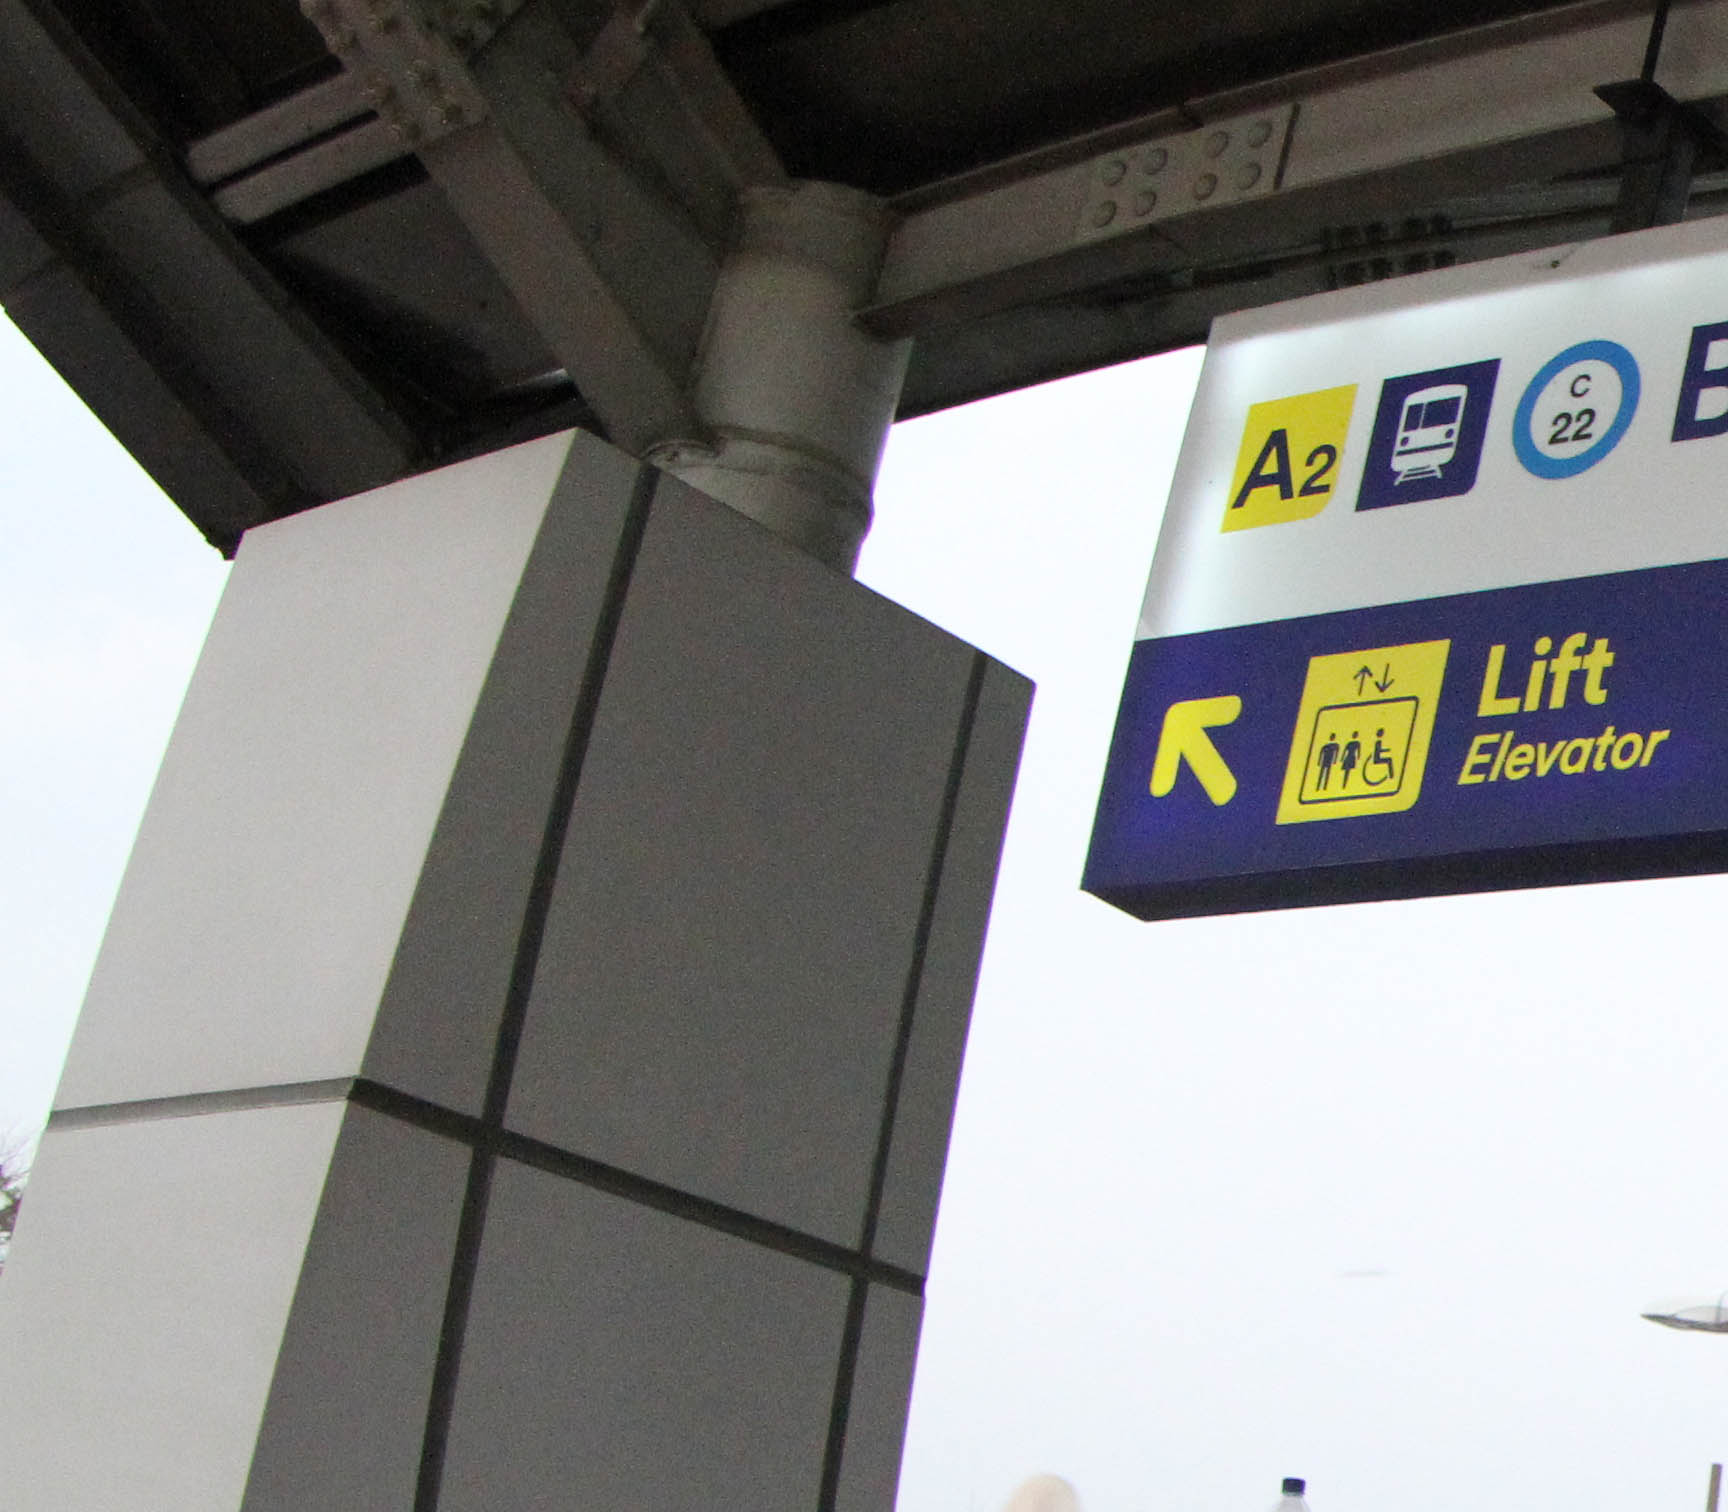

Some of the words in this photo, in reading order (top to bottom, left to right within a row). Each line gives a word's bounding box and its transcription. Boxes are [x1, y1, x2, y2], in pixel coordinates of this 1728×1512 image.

[1568, 372, 1593, 400] C
[1547, 407, 1597, 446] 22
[1231, 428, 1338, 509] A2
[1476, 631, 1615, 718] Lift
[1457, 726, 1670, 785] Elevator
